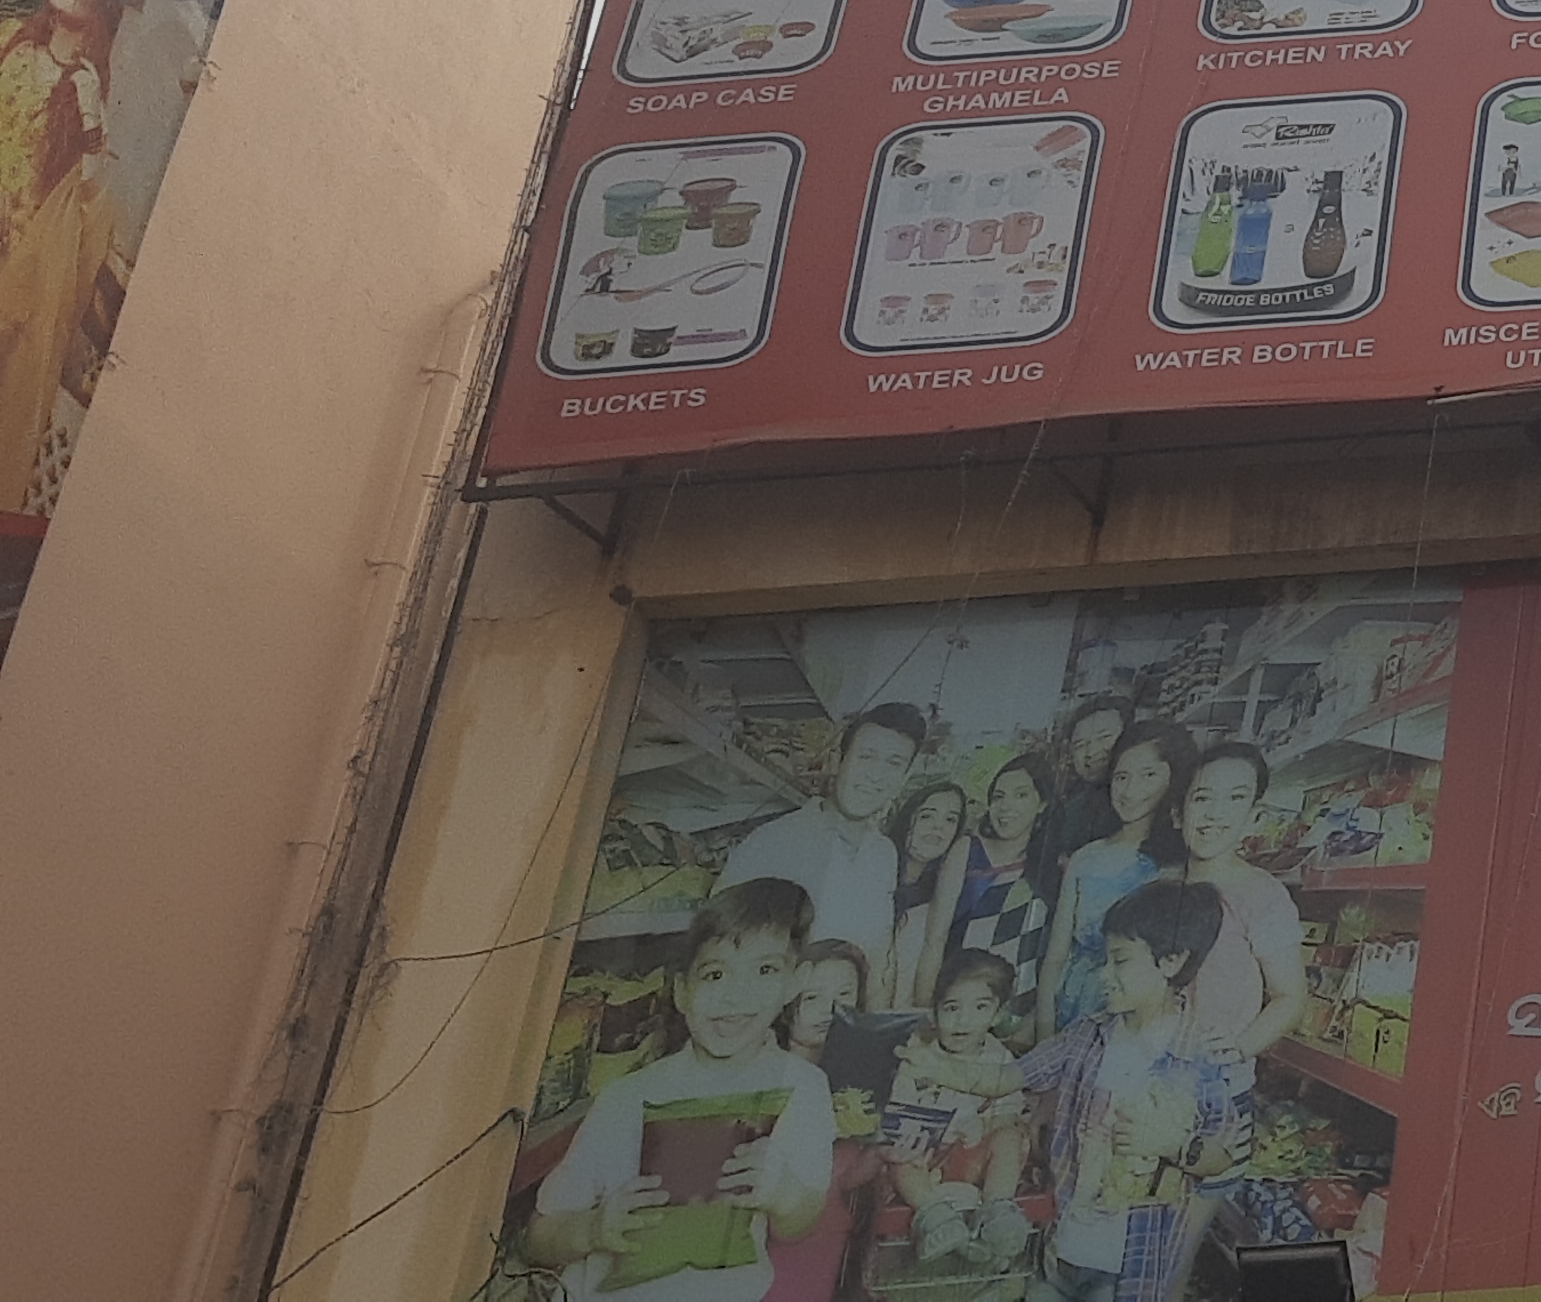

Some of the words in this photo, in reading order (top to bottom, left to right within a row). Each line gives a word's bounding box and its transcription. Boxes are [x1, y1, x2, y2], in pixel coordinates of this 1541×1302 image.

[1196, 44, 1327, 72] KITCHEN
[1336, 38, 1414, 62] TRAY
[891, 60, 1122, 94] MULTIPURPOSE
[627, 92, 708, 114] SOAP
[716, 84, 797, 108] CASE
[922, 87, 1070, 114] GHAMELA
[1195, 287, 1258, 310] FRIDGE
[1259, 281, 1335, 308] BOTTLES
[1135, 346, 1242, 372] WATER
[1251, 338, 1376, 366] BOTTLE
[866, 367, 974, 393] WATER
[981, 361, 1045, 385] JUG
[560, 387, 707, 419] BUCKETS
